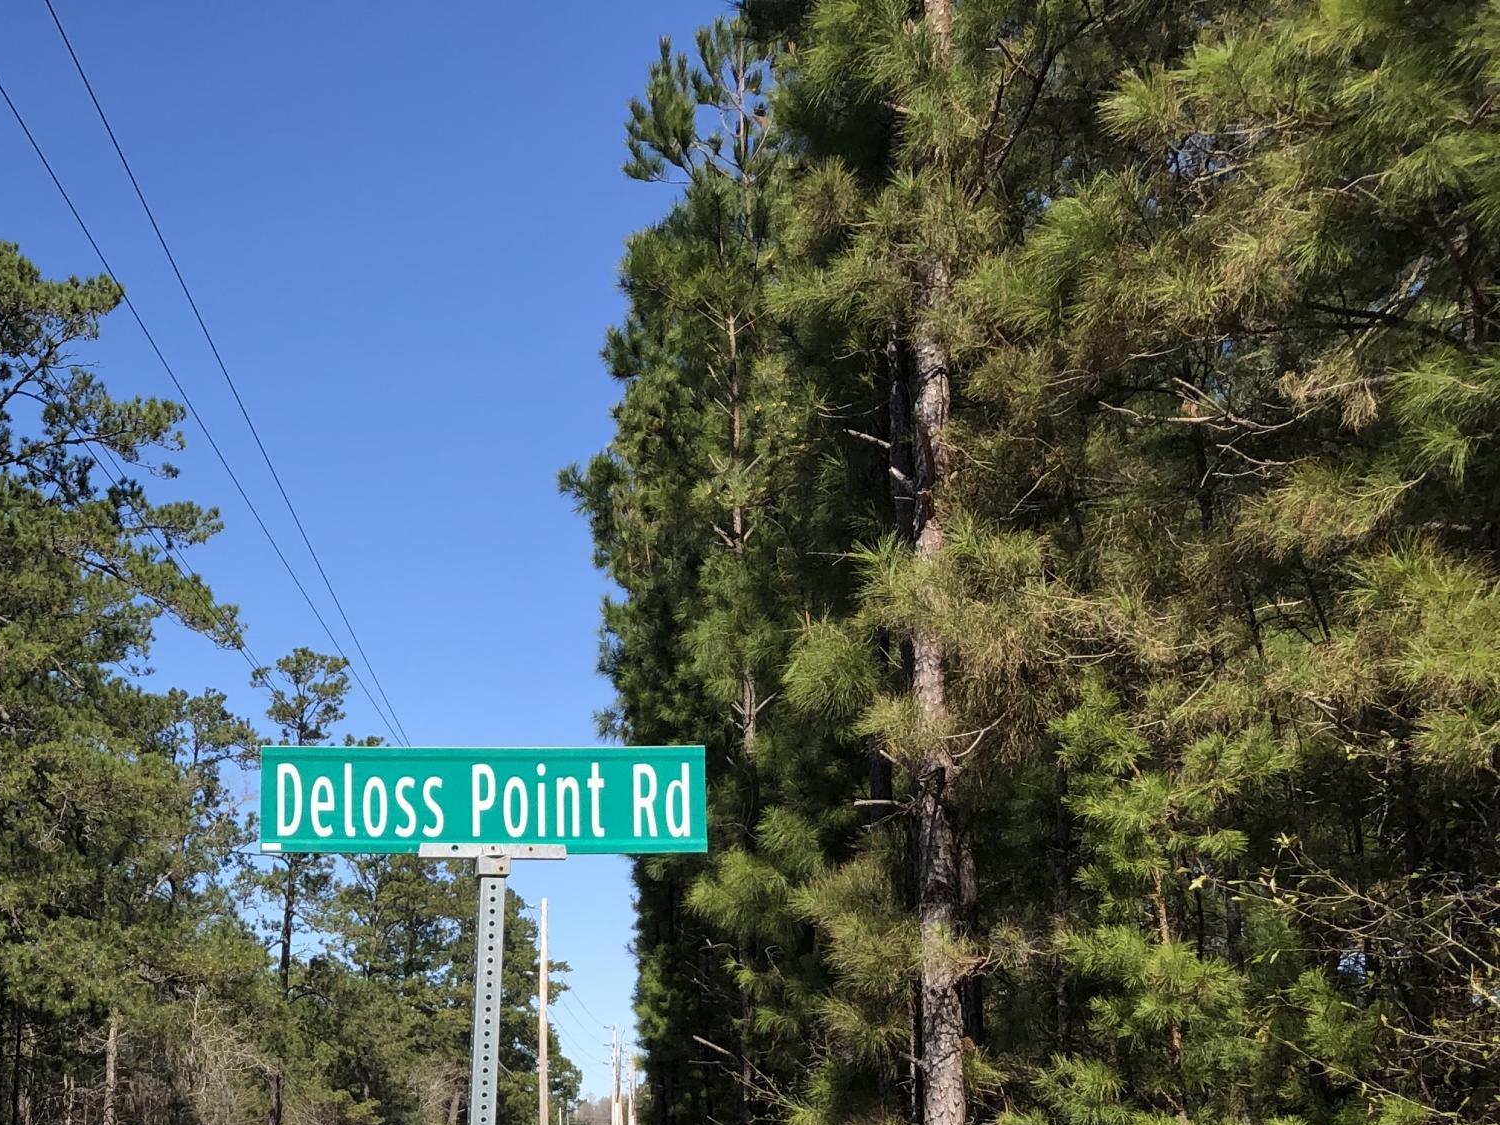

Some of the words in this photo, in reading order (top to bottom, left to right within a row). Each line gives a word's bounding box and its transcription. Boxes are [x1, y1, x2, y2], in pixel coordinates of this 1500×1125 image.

[277, 763, 444, 838] Deloss
[472, 762, 605, 838] Point
[632, 762, 691, 838] Rd
